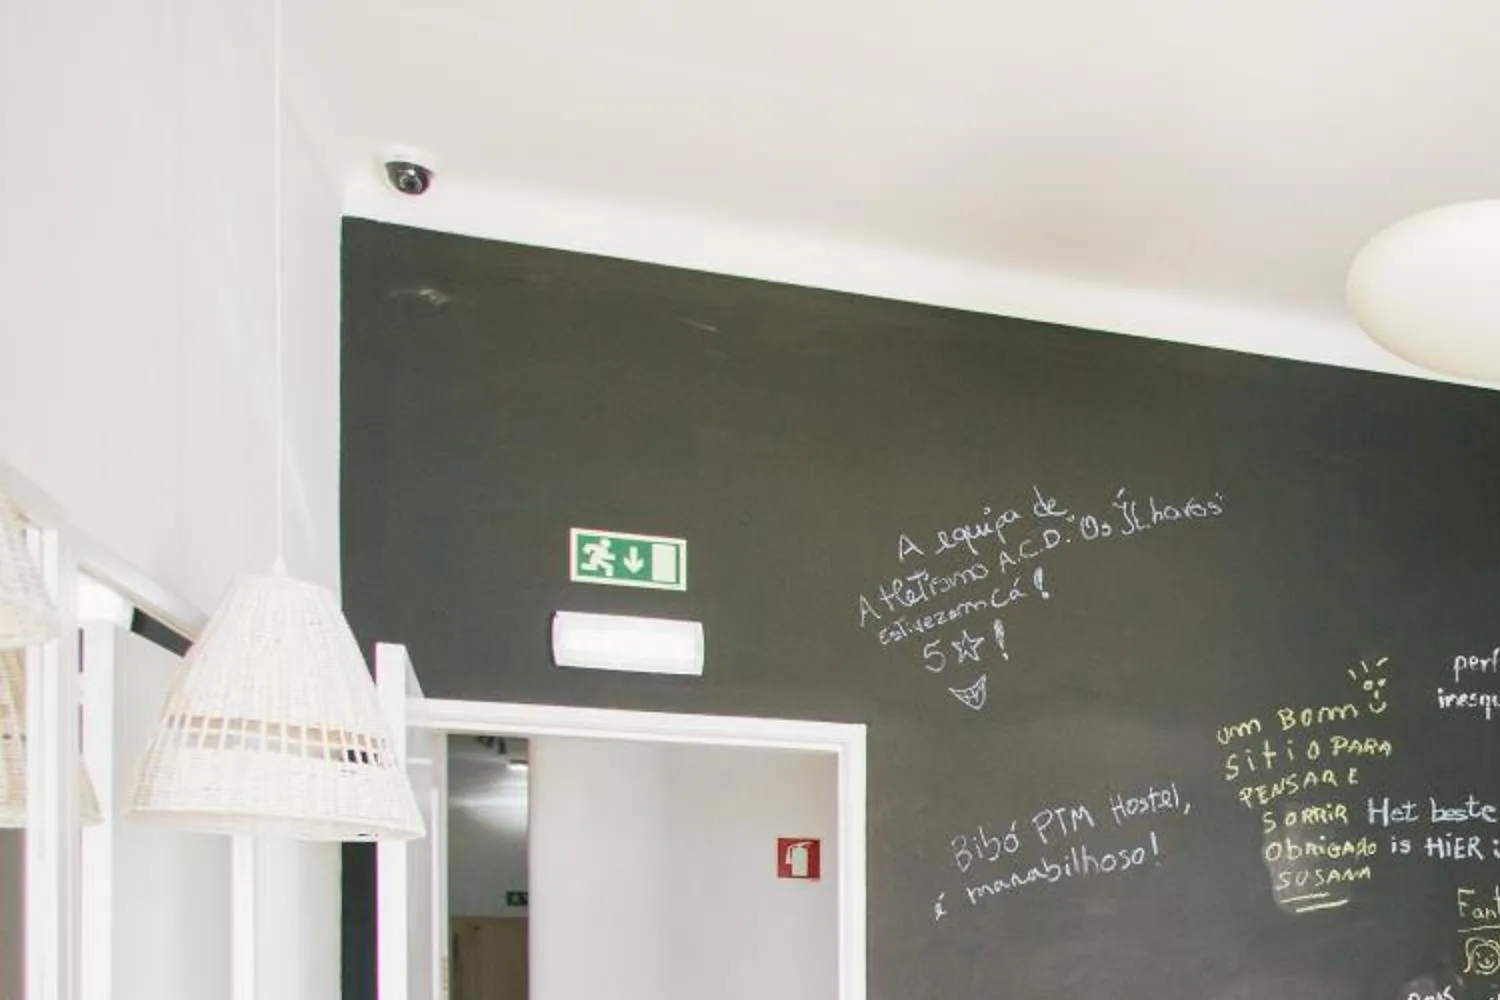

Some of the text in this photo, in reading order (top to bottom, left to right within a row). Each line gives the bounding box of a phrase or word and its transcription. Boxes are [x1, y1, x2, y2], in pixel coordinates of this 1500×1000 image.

[899, 534, 924, 562] A
[935, 506, 1022, 556] equipa
[922, 640, 946, 672] 5
[1330, 736, 1392, 757] PARA
[1032, 804, 1094, 844] PTM
[1367, 797, 1419, 826] Het
[1275, 866, 1370, 891] SUSANA
